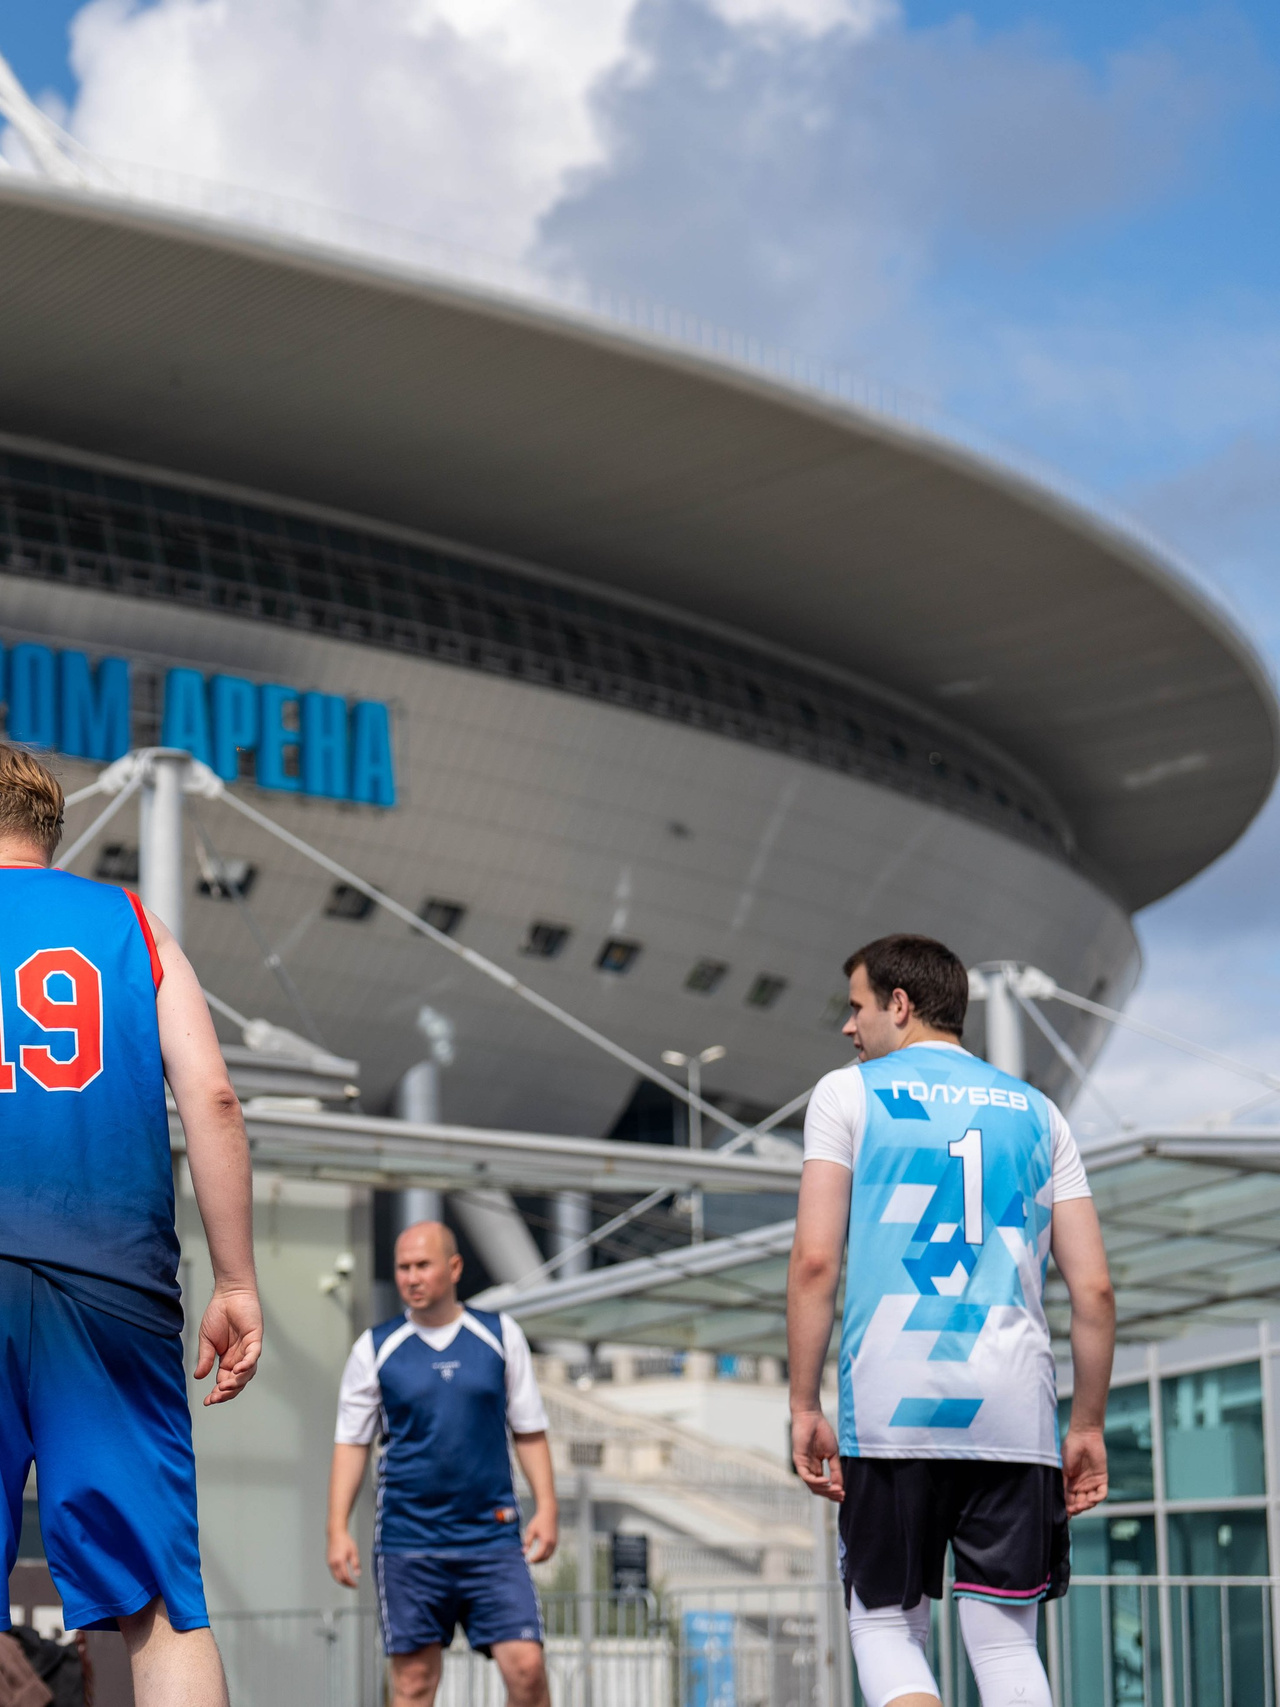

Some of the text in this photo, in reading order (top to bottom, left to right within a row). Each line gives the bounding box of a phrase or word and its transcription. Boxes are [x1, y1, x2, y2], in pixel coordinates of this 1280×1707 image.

[160, 667, 396, 808] АРЕНА
[891, 1080, 1029, 1112] ГОЛУБЕВ
[948, 1128, 983, 1245] 1
